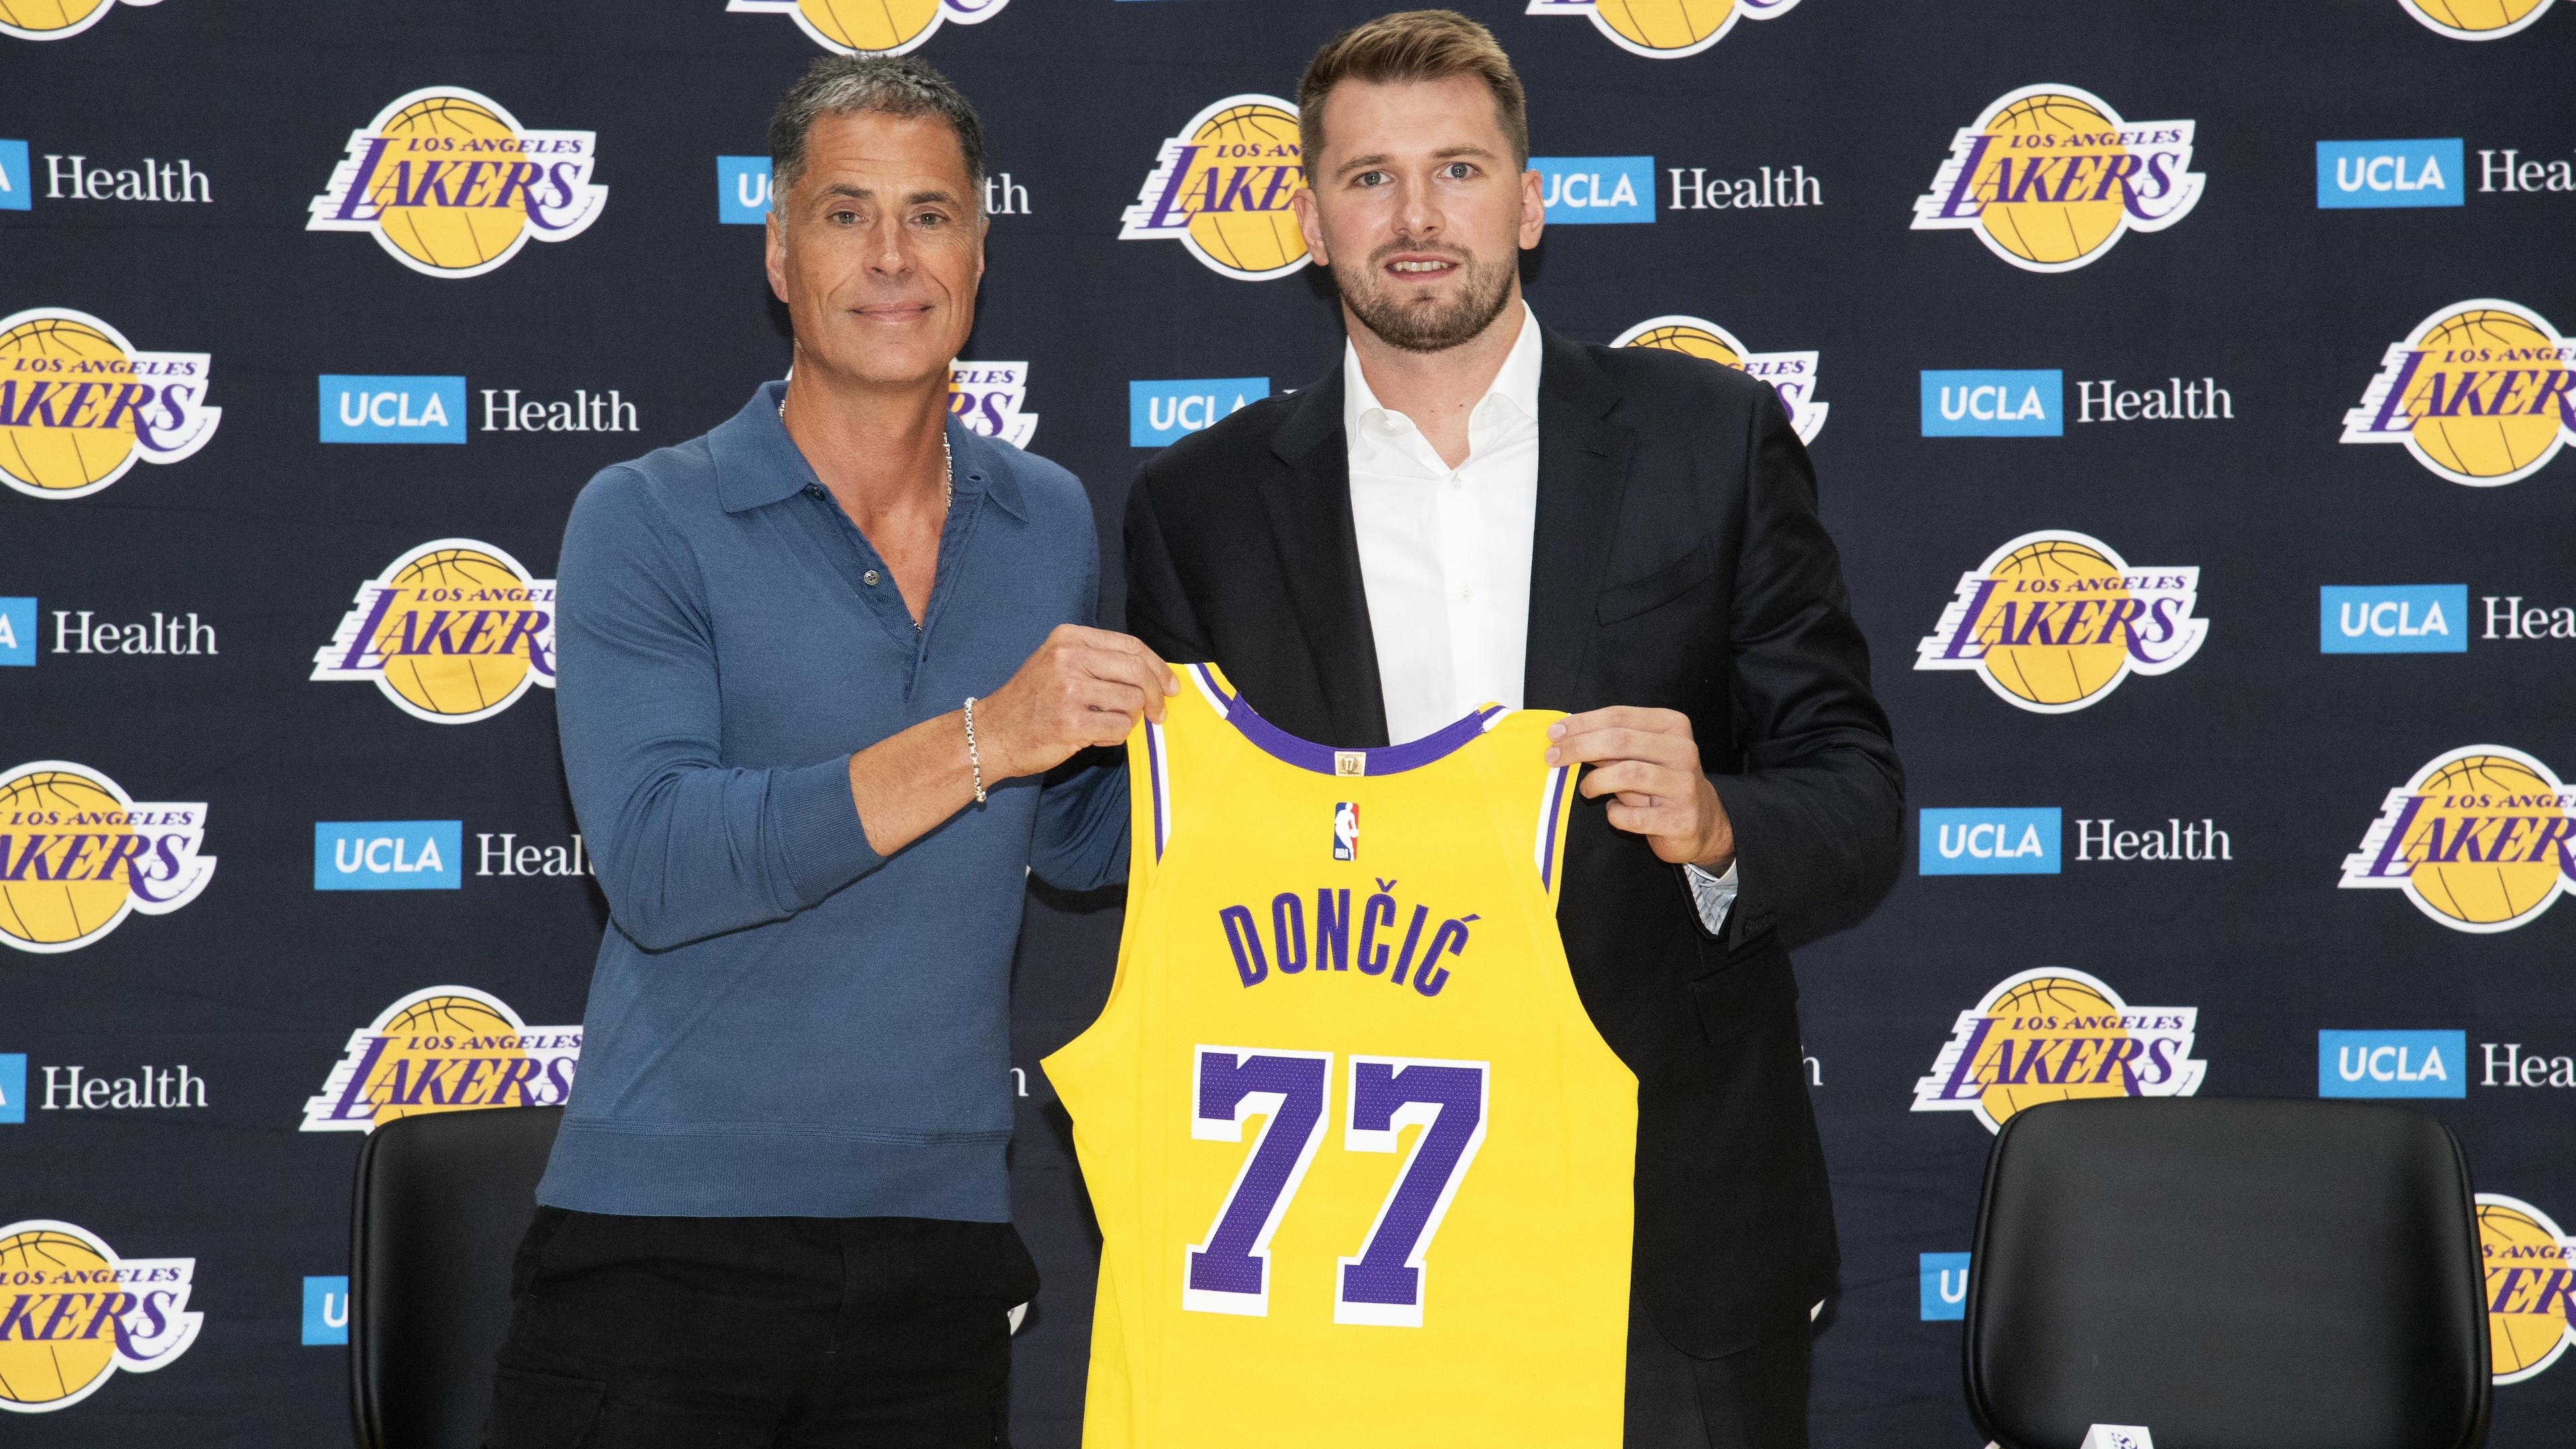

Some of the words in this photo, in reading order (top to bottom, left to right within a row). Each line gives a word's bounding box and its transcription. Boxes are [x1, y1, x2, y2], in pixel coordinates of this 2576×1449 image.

[407, 138, 455, 152] LOS
[461, 138, 584, 154] ANGELES
[1216, 144, 1262, 158] LOS
[2009, 134, 2057, 148] LOS
[2060, 129, 2183, 147] ANGELES
[45, 156, 213, 202] Health
[322, 138, 594, 231] LAKERS
[1134, 146, 1307, 229] LAKE
[1669, 166, 1823, 209] Health
[1927, 135, 2192, 221] LAKERS
[2337, 156, 2445, 192] UCLA
[2478, 150, 2576, 192] Hea
[13, 358, 64, 372] LOS
[68, 360, 198, 376] ANGELES
[1727, 360, 1806, 375] ELES
[2443, 348, 2492, 363] LOS
[2496, 347, 2576, 362] ANGE
[950, 370, 1016, 383] ELES
[2356, 350, 2576, 433] LAKER
[340, 392, 448, 427] UCLA
[482, 390, 639, 431] Health
[1941, 385, 2045, 421] UCLA
[2077, 378, 2233, 422] Health
[416, 588, 464, 602] LOS
[468, 588, 555, 602] ANGEL
[2014, 579, 2061, 593] LOS
[2066, 576, 2188, 592] ANGELES
[53, 612, 218, 654] Health
[1929, 580, 2196, 664] LAKERS
[2341, 600, 2449, 637] UCLA
[2483, 596, 2576, 639] Hea
[9, 812, 60, 825] LOS
[64, 812, 194, 825] ANGELES
[2443, 794, 2491, 808] LOS
[2496, 794, 2576, 808] ANGE
[335, 837, 443, 873] UCLA
[477, 834, 595, 875] Heal
[1335, 848, 1349, 859] NBA
[1939, 823, 2043, 859] UCLA
[2076, 819, 2231, 860] Health
[2354, 796, 2576, 881] LAKER
[1220, 878, 1481, 997] DONČIĆ
[407, 1036, 455, 1050] LOS
[459, 1034, 583, 1050] ANGELES
[2011, 1016, 2059, 1030] LOS
[2063, 1015, 2185, 1030] ANGELES
[1926, 1017, 2193, 1097] LAKERS
[2339, 1046, 2447, 1081] UCLA
[2481, 1043, 2576, 1087] Hea
[42, 1065, 208, 1109] Health
[317, 1037, 577, 1120] LAKERS
[1182, 1044, 1491, 1328] 77
[2498, 1244, 2576, 1260] ANGE
[51, 1267, 182, 1284] ANGELES
[0, 1290, 189, 1361] KERS
